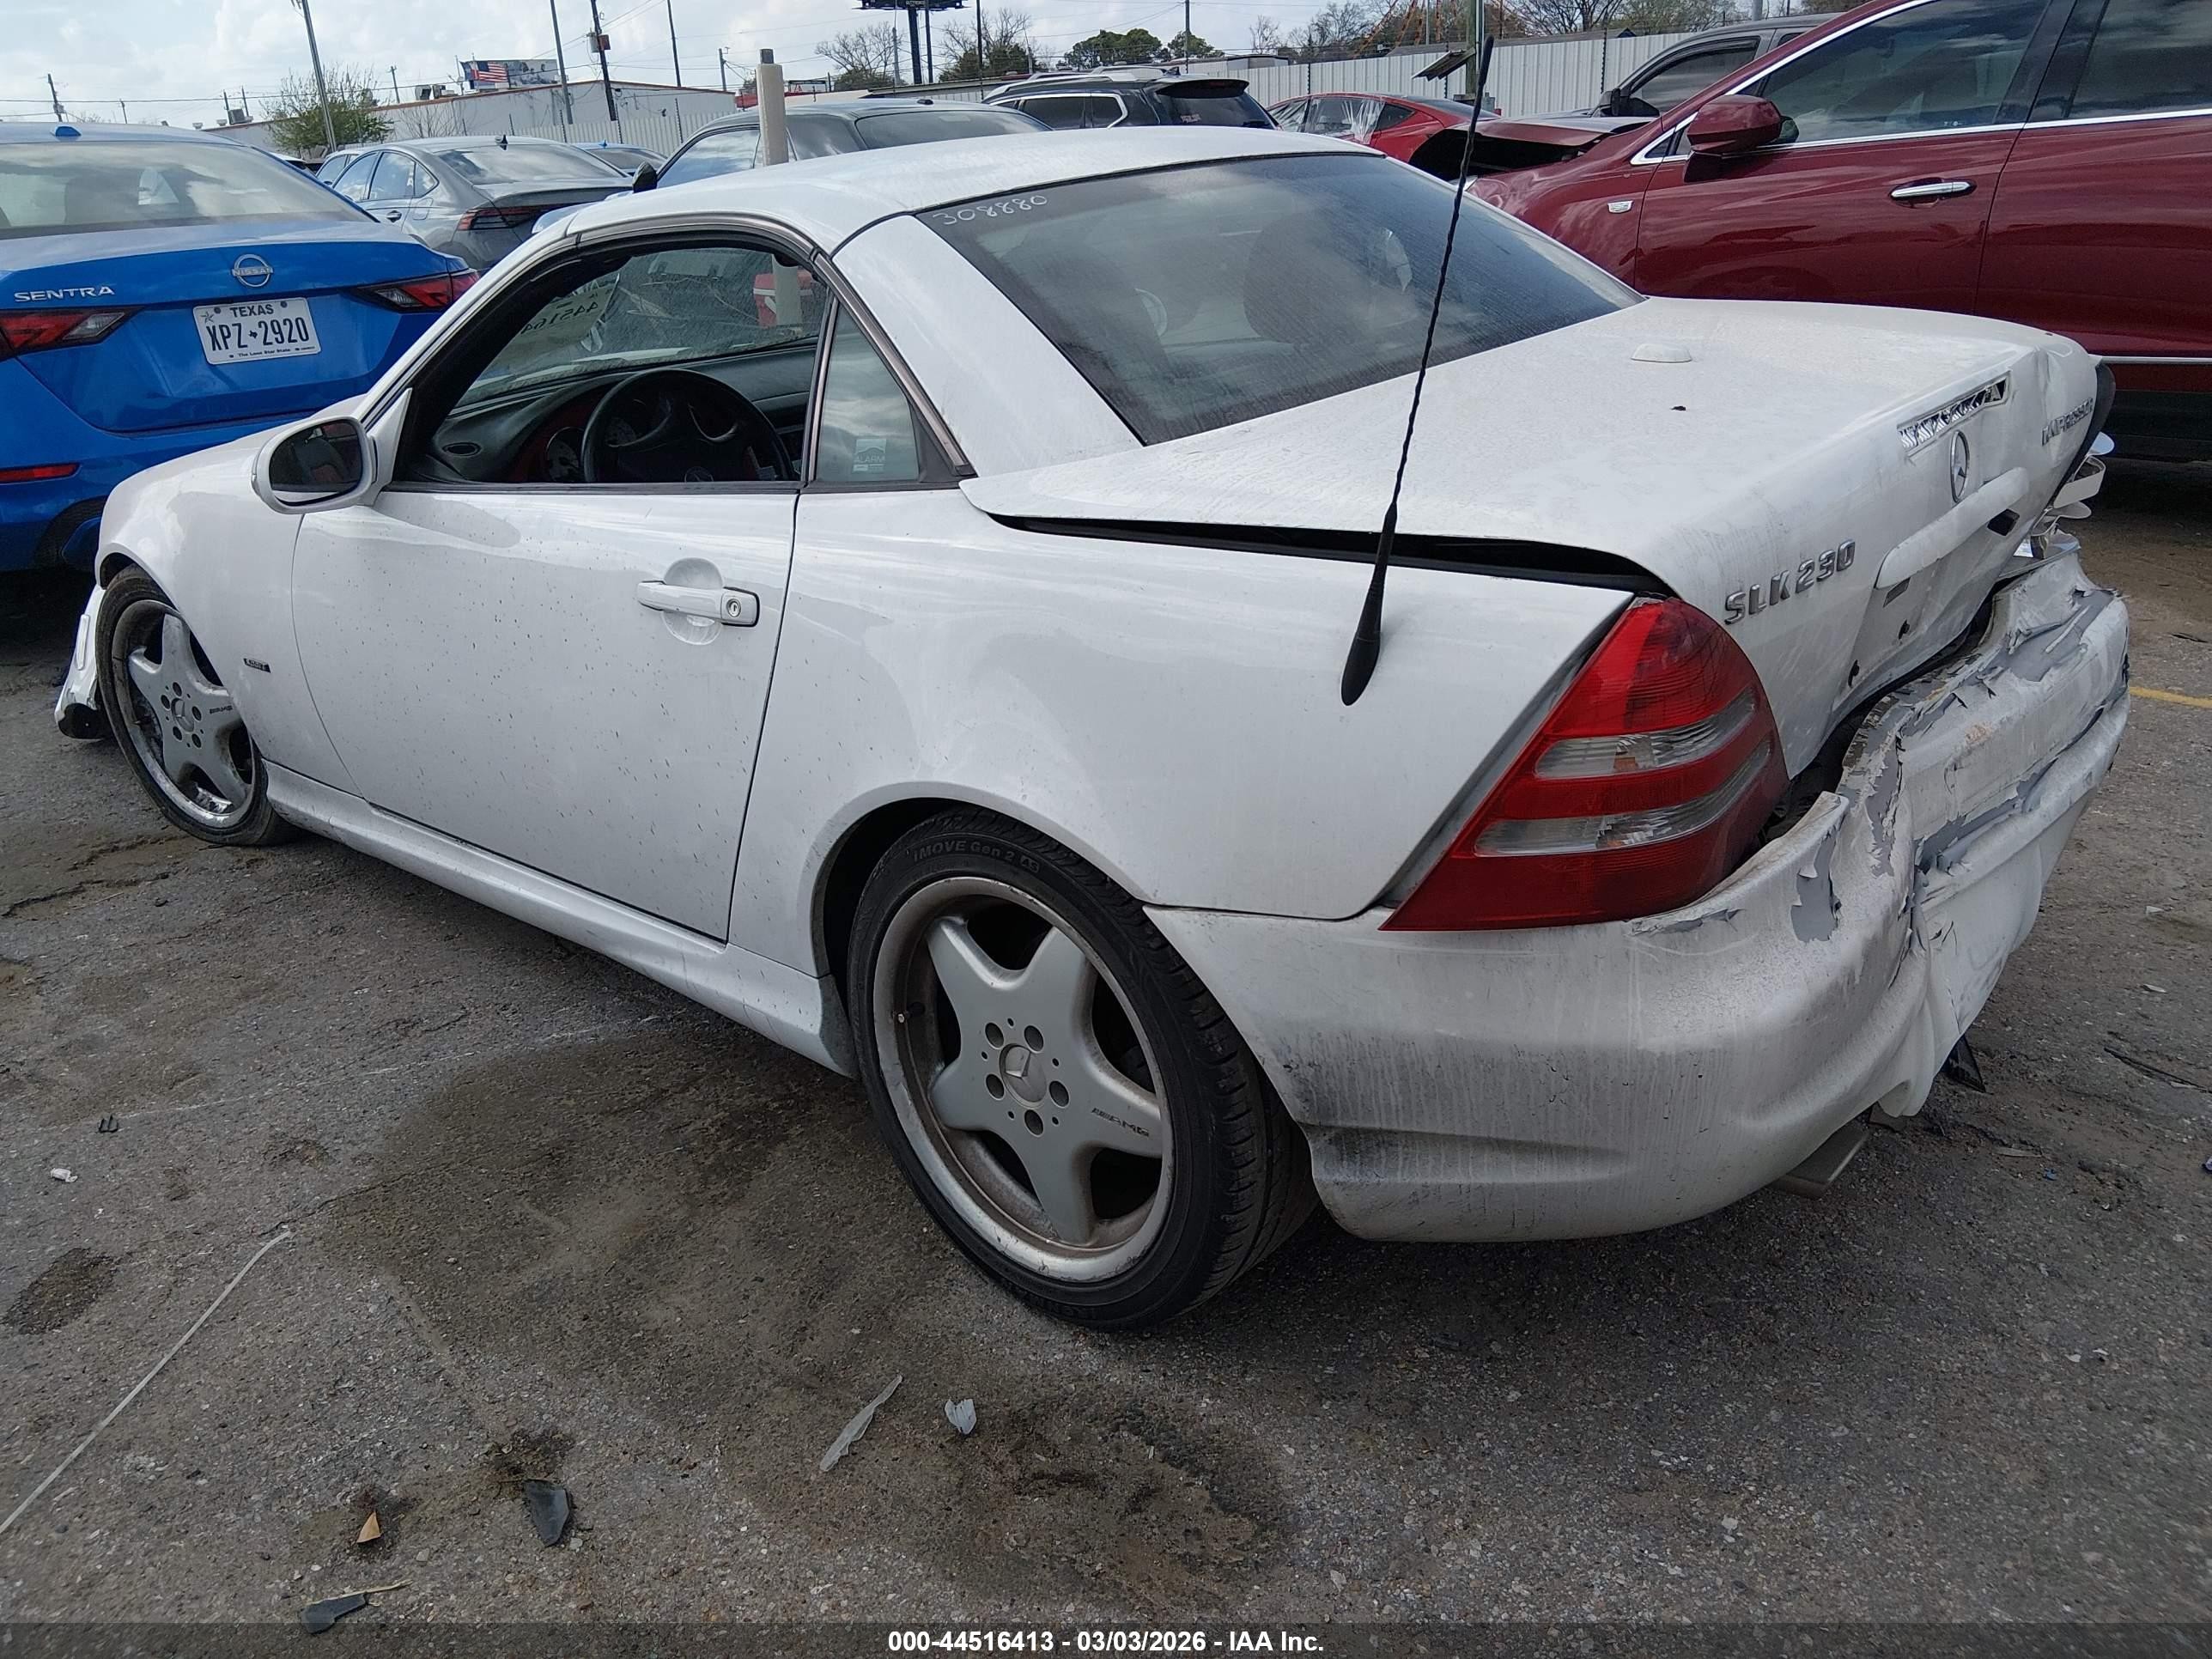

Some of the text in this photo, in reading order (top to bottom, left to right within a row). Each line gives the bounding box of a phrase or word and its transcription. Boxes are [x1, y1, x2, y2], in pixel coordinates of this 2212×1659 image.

[932, 195, 1048, 225] 308880
[232, 267, 274, 276] NISSAN
[14, 285, 116, 302] SENTRA
[230, 304, 274, 318] TEXAS
[206, 317, 309, 351] XPZ 2920
[970, 842, 1000, 858] Gen
[1004, 851, 1014, 862] 2
